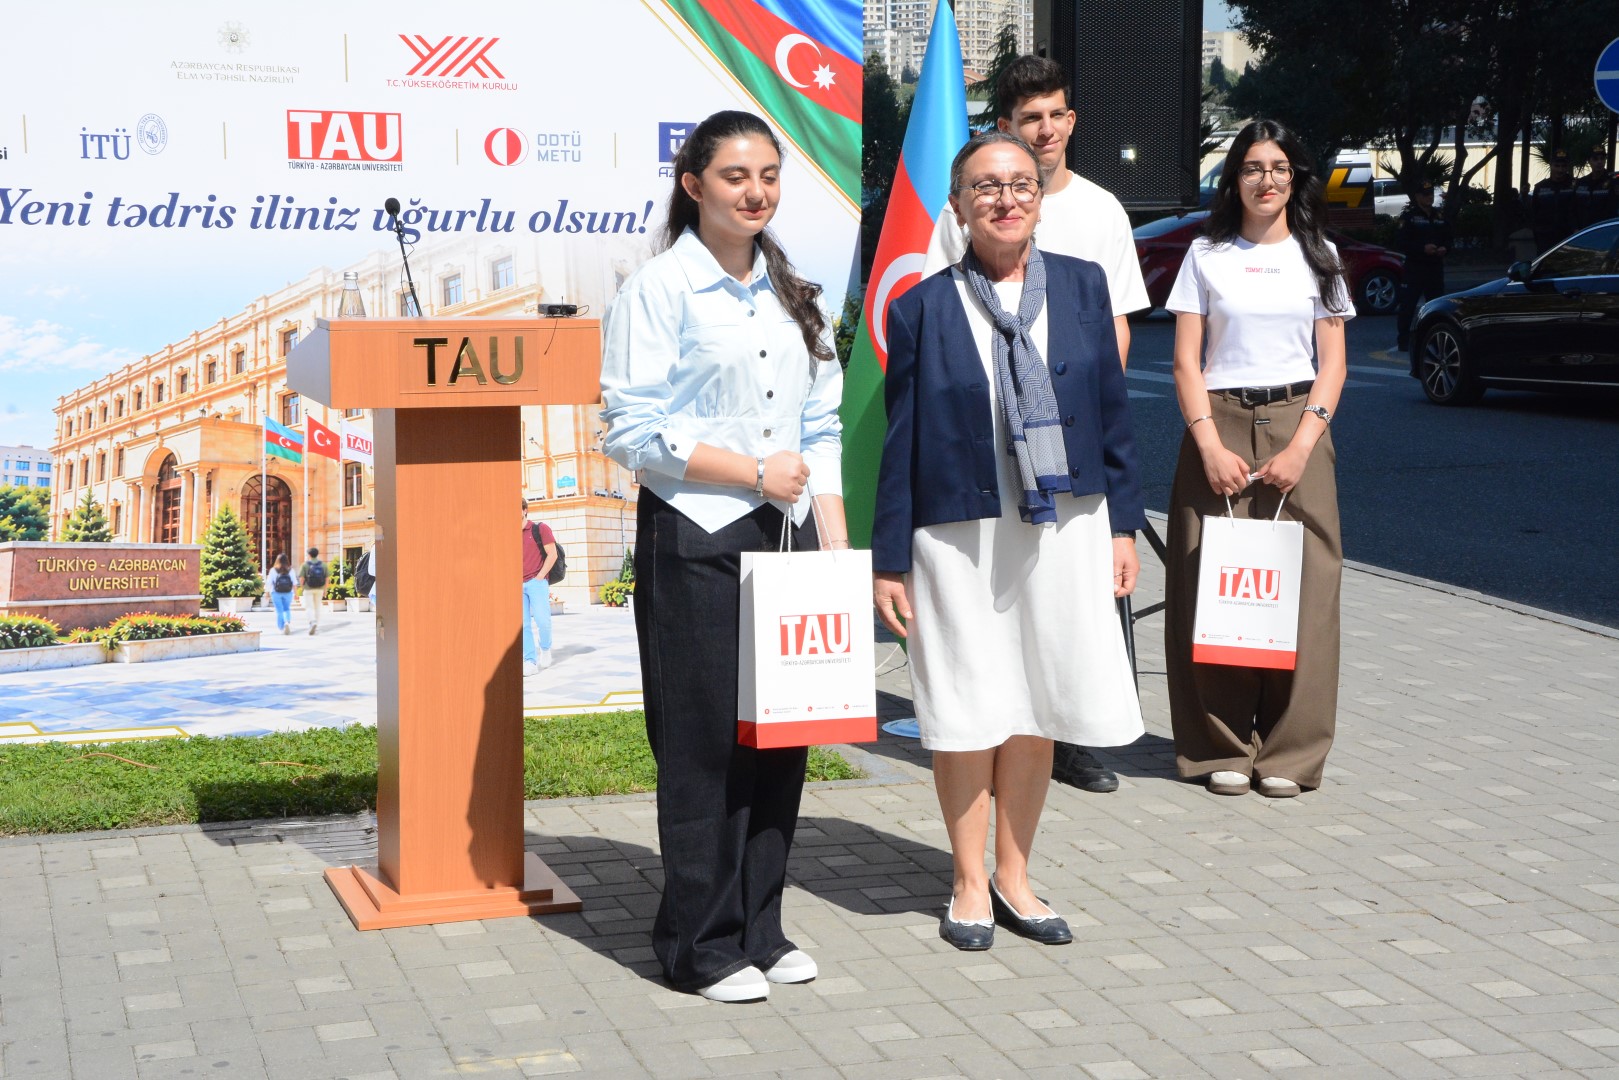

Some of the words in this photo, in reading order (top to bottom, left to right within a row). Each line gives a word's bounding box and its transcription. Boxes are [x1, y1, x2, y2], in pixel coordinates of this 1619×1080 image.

[170, 60, 233, 71] AZƏRBAYCAN
[177, 71, 198, 80] ELM
[402, 78, 479, 90] YÜKSEKÖĞRETİM
[482, 82, 518, 91] KURULU
[80, 126, 131, 160] İTÜ
[288, 110, 400, 161] TAU
[537, 130, 581, 147] ODTÜ
[537, 149, 581, 162] METU
[288, 160, 314, 170] TÜRKİYƏ
[320, 162, 361, 171] AZƏRBAYCAN
[362, 162, 403, 172] UNİVERSİTETİ
[0, 188, 94, 226] Yeni
[107, 192, 236, 229] tədris
[250, 194, 360, 230] iliniz
[373, 198, 515, 245] uğurlu
[528, 199, 654, 234] olsun!
[413, 335, 524, 387] TAU
[347, 434, 371, 453] TAU
[37, 556, 97, 573] TÜRKİYƏ
[108, 559, 186, 572] AZƏRBAYCAN
[69, 574, 160, 591] UNİVERSİTETİ
[1221, 567, 1279, 600] TAU
[781, 613, 850, 656] TAU
